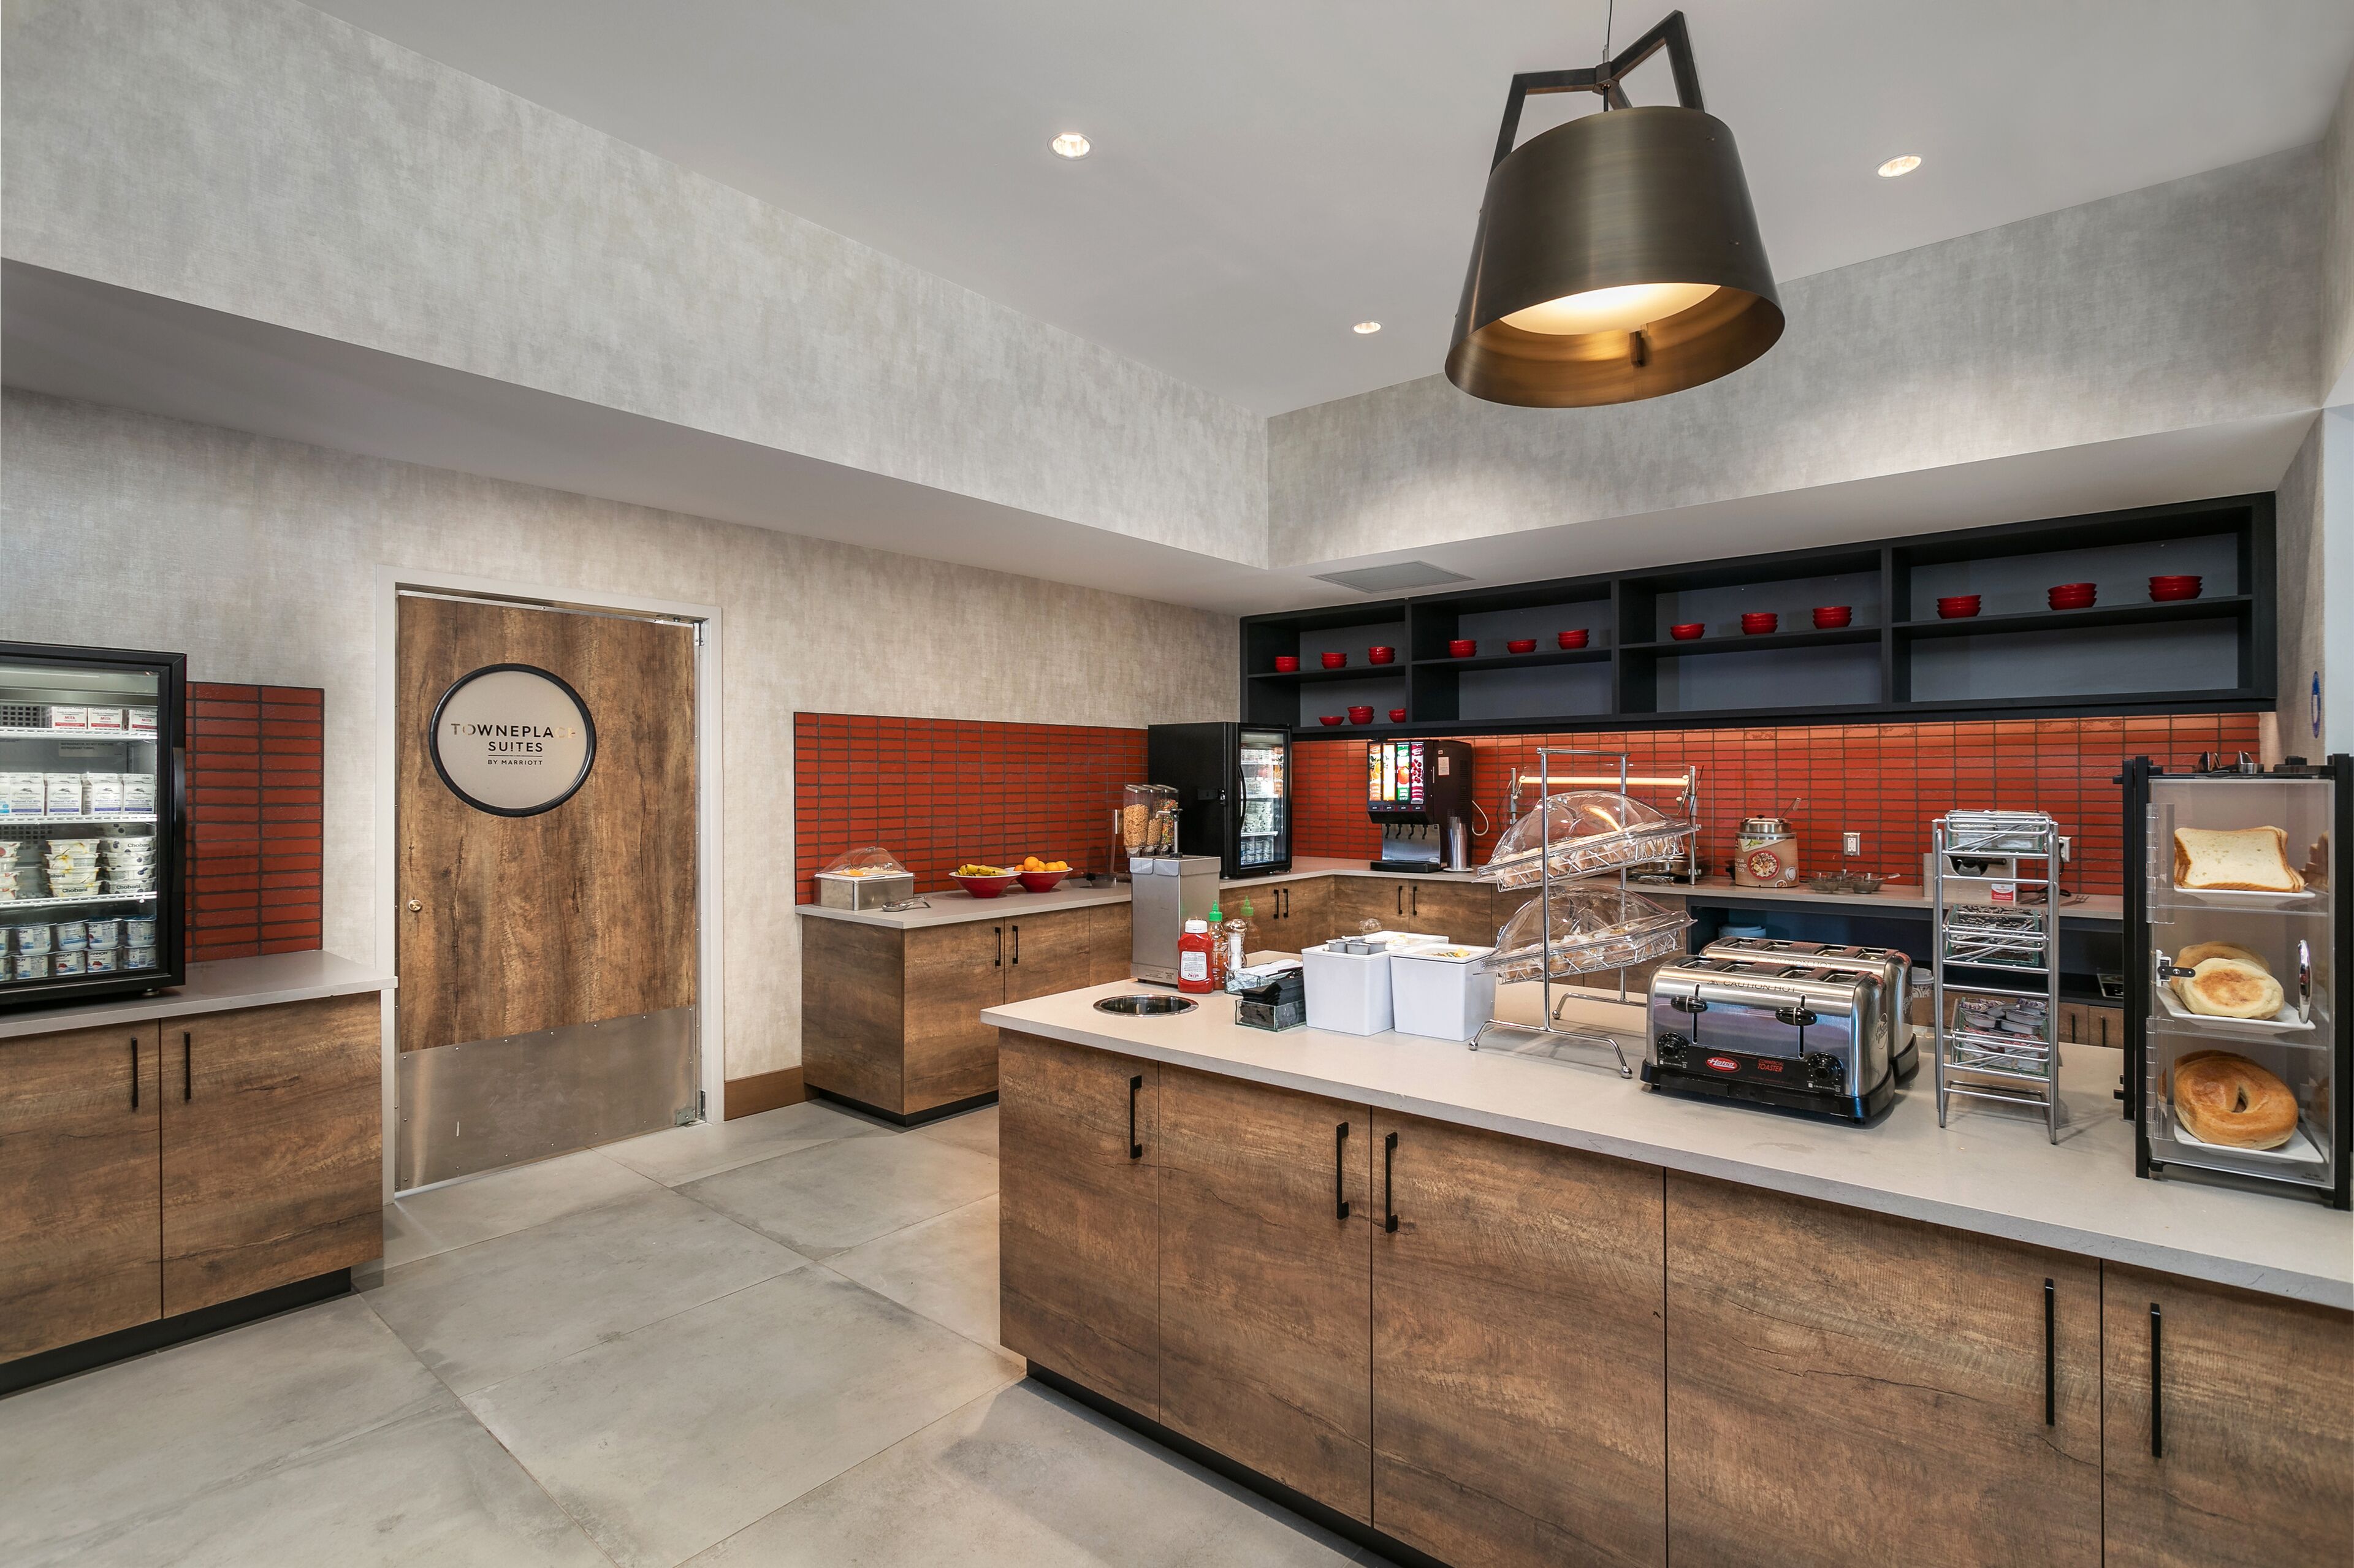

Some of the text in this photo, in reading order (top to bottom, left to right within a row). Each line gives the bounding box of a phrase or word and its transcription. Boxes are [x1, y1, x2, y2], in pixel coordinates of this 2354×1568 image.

[488, 741, 543, 752] SUITES
[1723, 981, 1770, 990] CAUTION
[1707, 1058, 1734, 1067] Hatco
[1758, 1064, 1783, 1072] TOASTER
